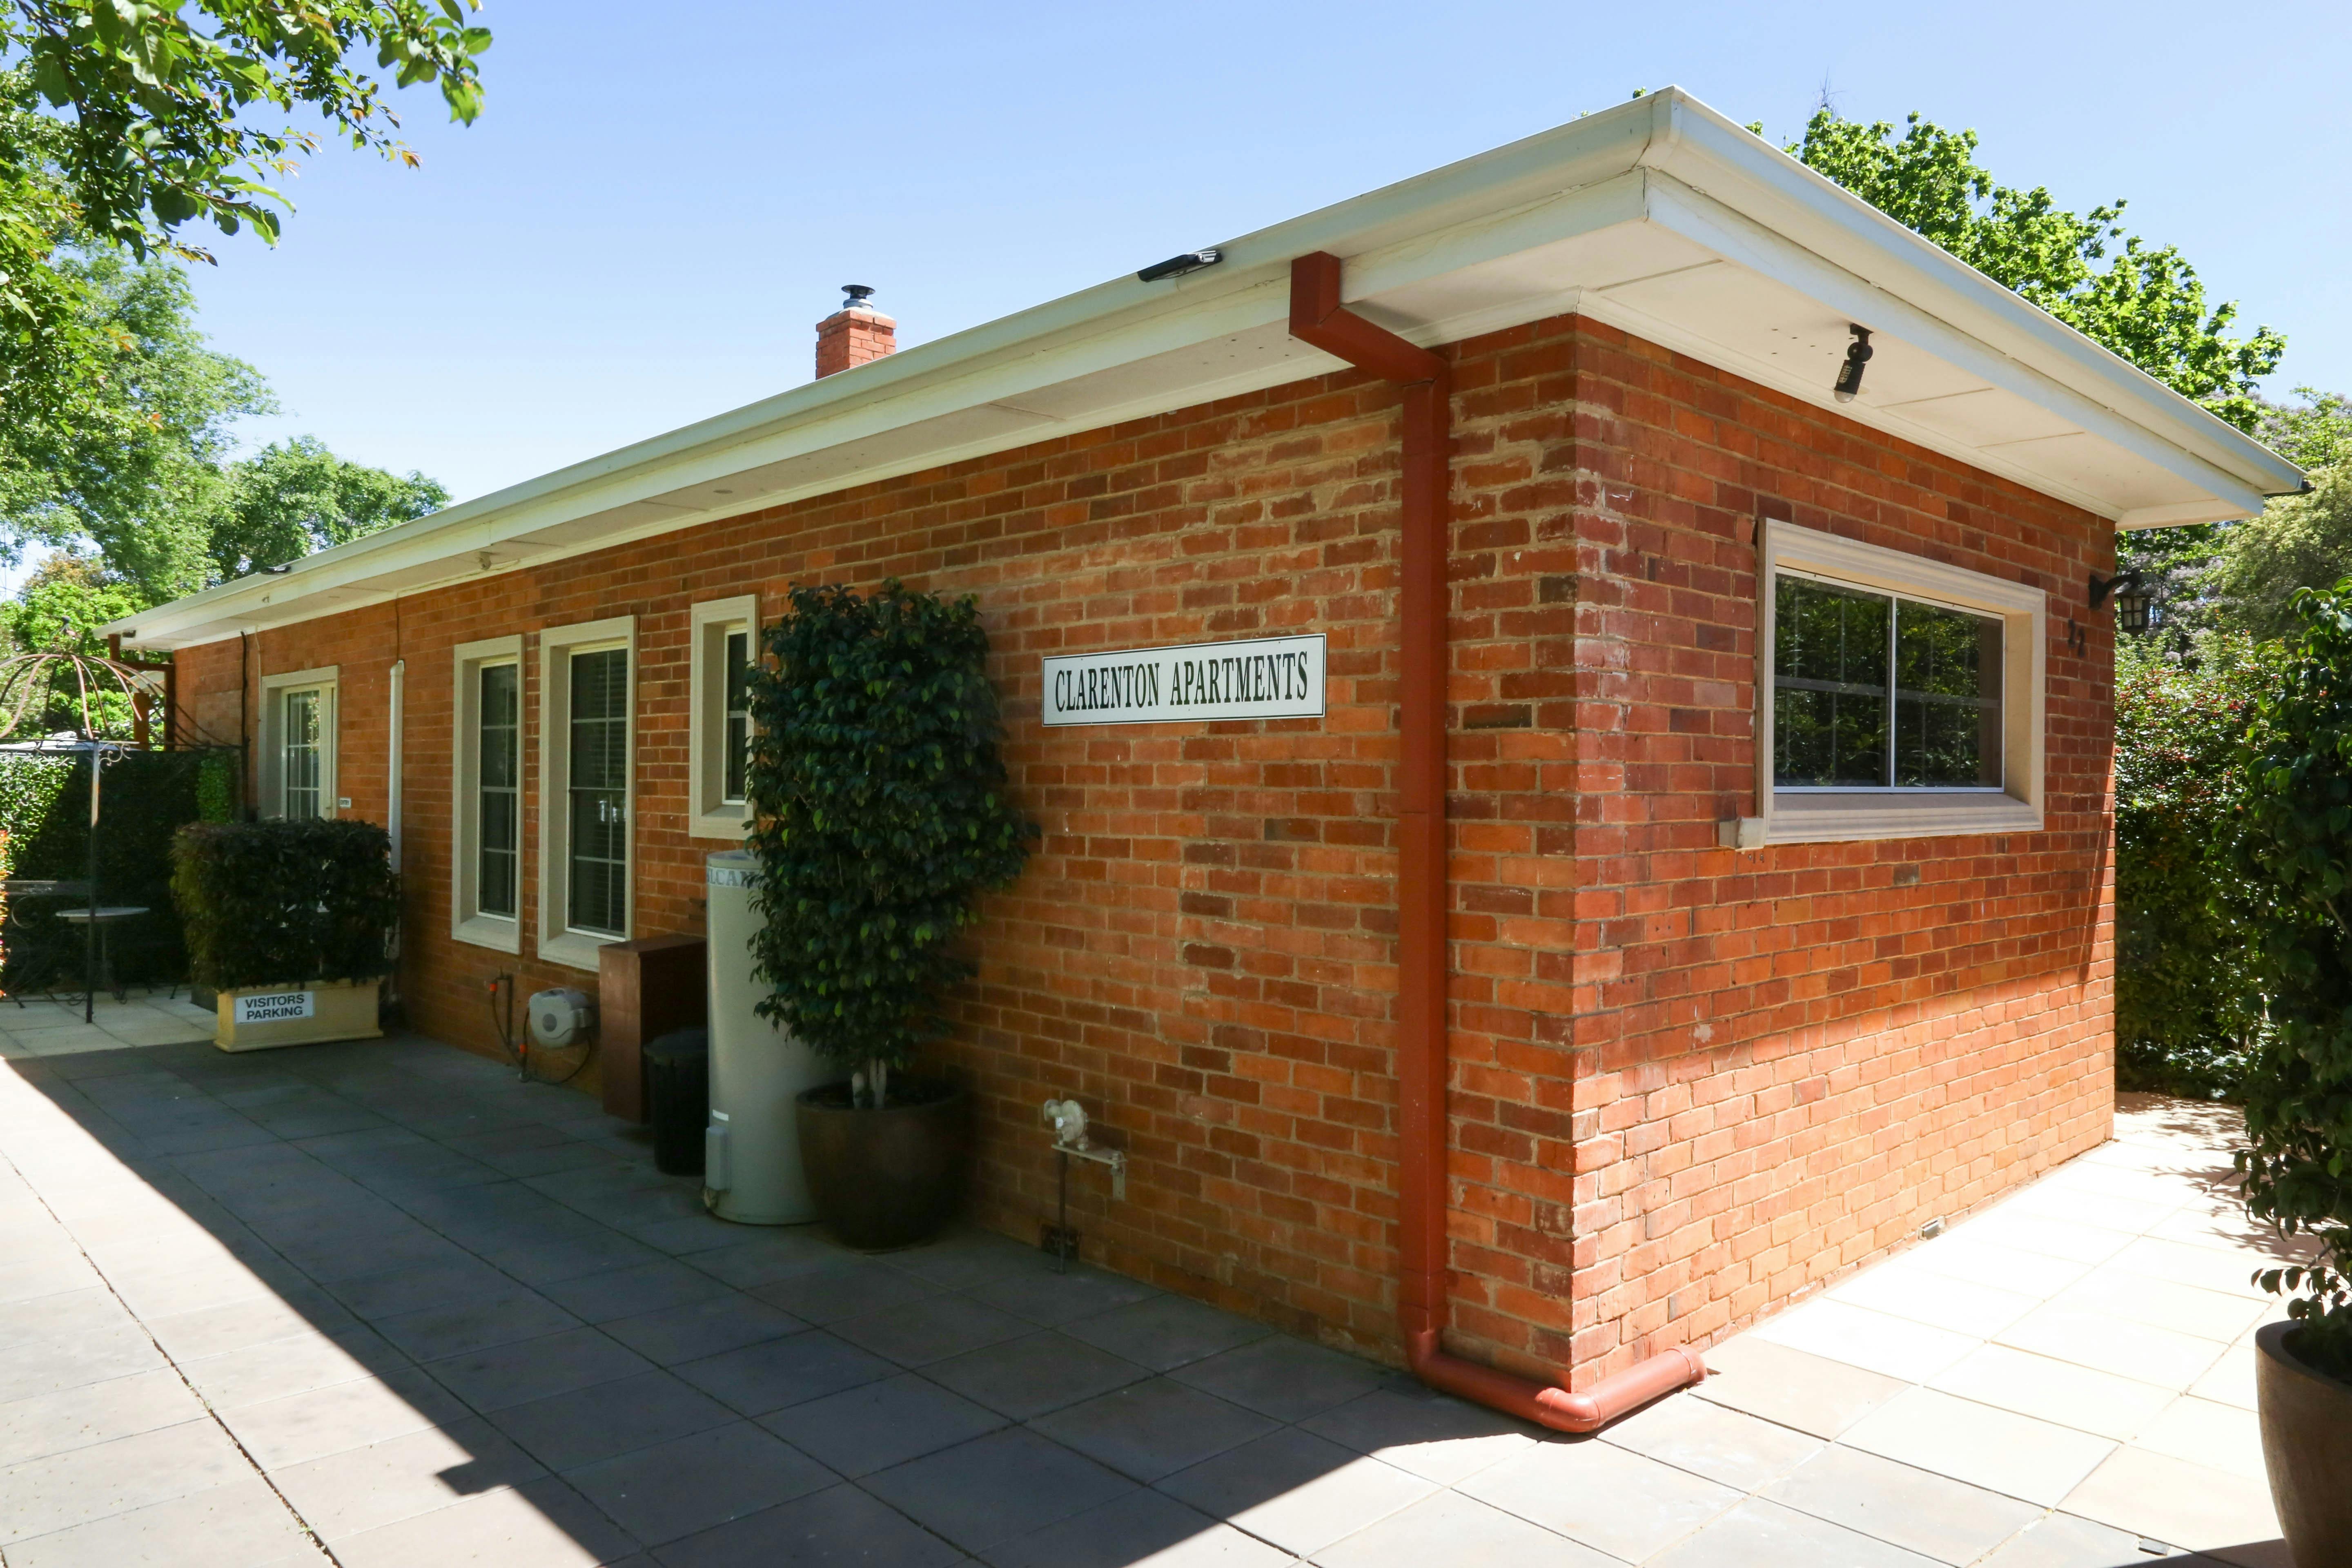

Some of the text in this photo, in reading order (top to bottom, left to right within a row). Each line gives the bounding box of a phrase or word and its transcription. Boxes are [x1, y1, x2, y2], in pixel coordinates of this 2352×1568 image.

[1055, 651, 1307, 712] CLARENTON APARTMENTS
[245, 994, 305, 1008] VISITORS
[247, 1006, 303, 1020] PARKING
